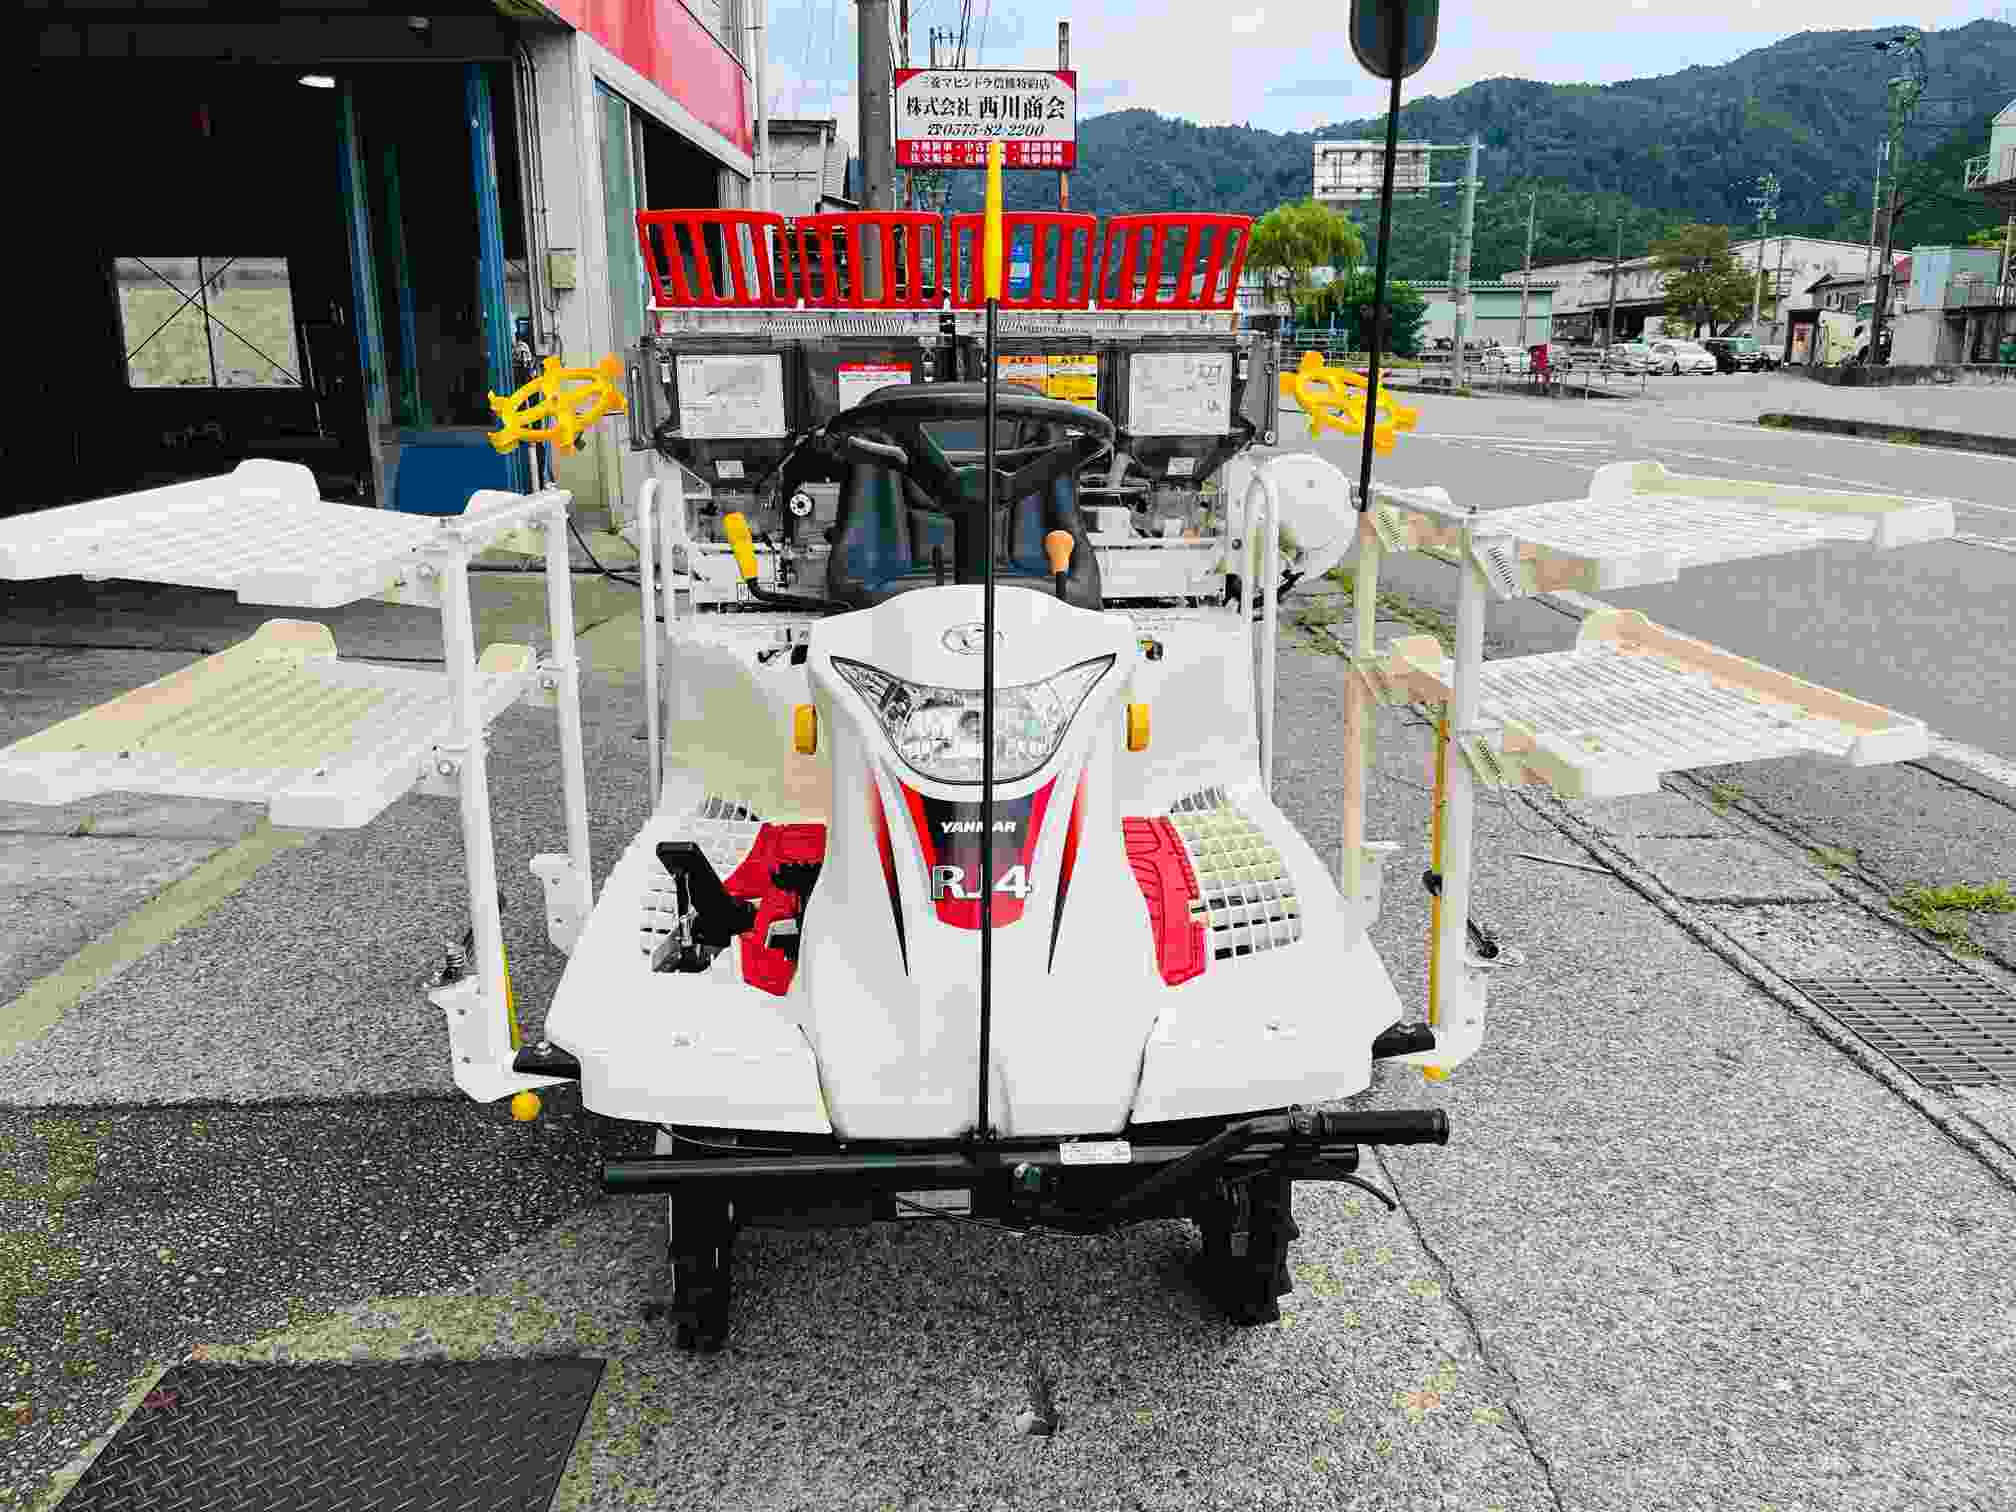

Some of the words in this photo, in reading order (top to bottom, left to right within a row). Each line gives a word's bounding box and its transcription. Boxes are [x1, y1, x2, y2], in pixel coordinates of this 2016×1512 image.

[906, 95, 972, 117] 株式会社
[979, 95, 1065, 120] 西川商会
